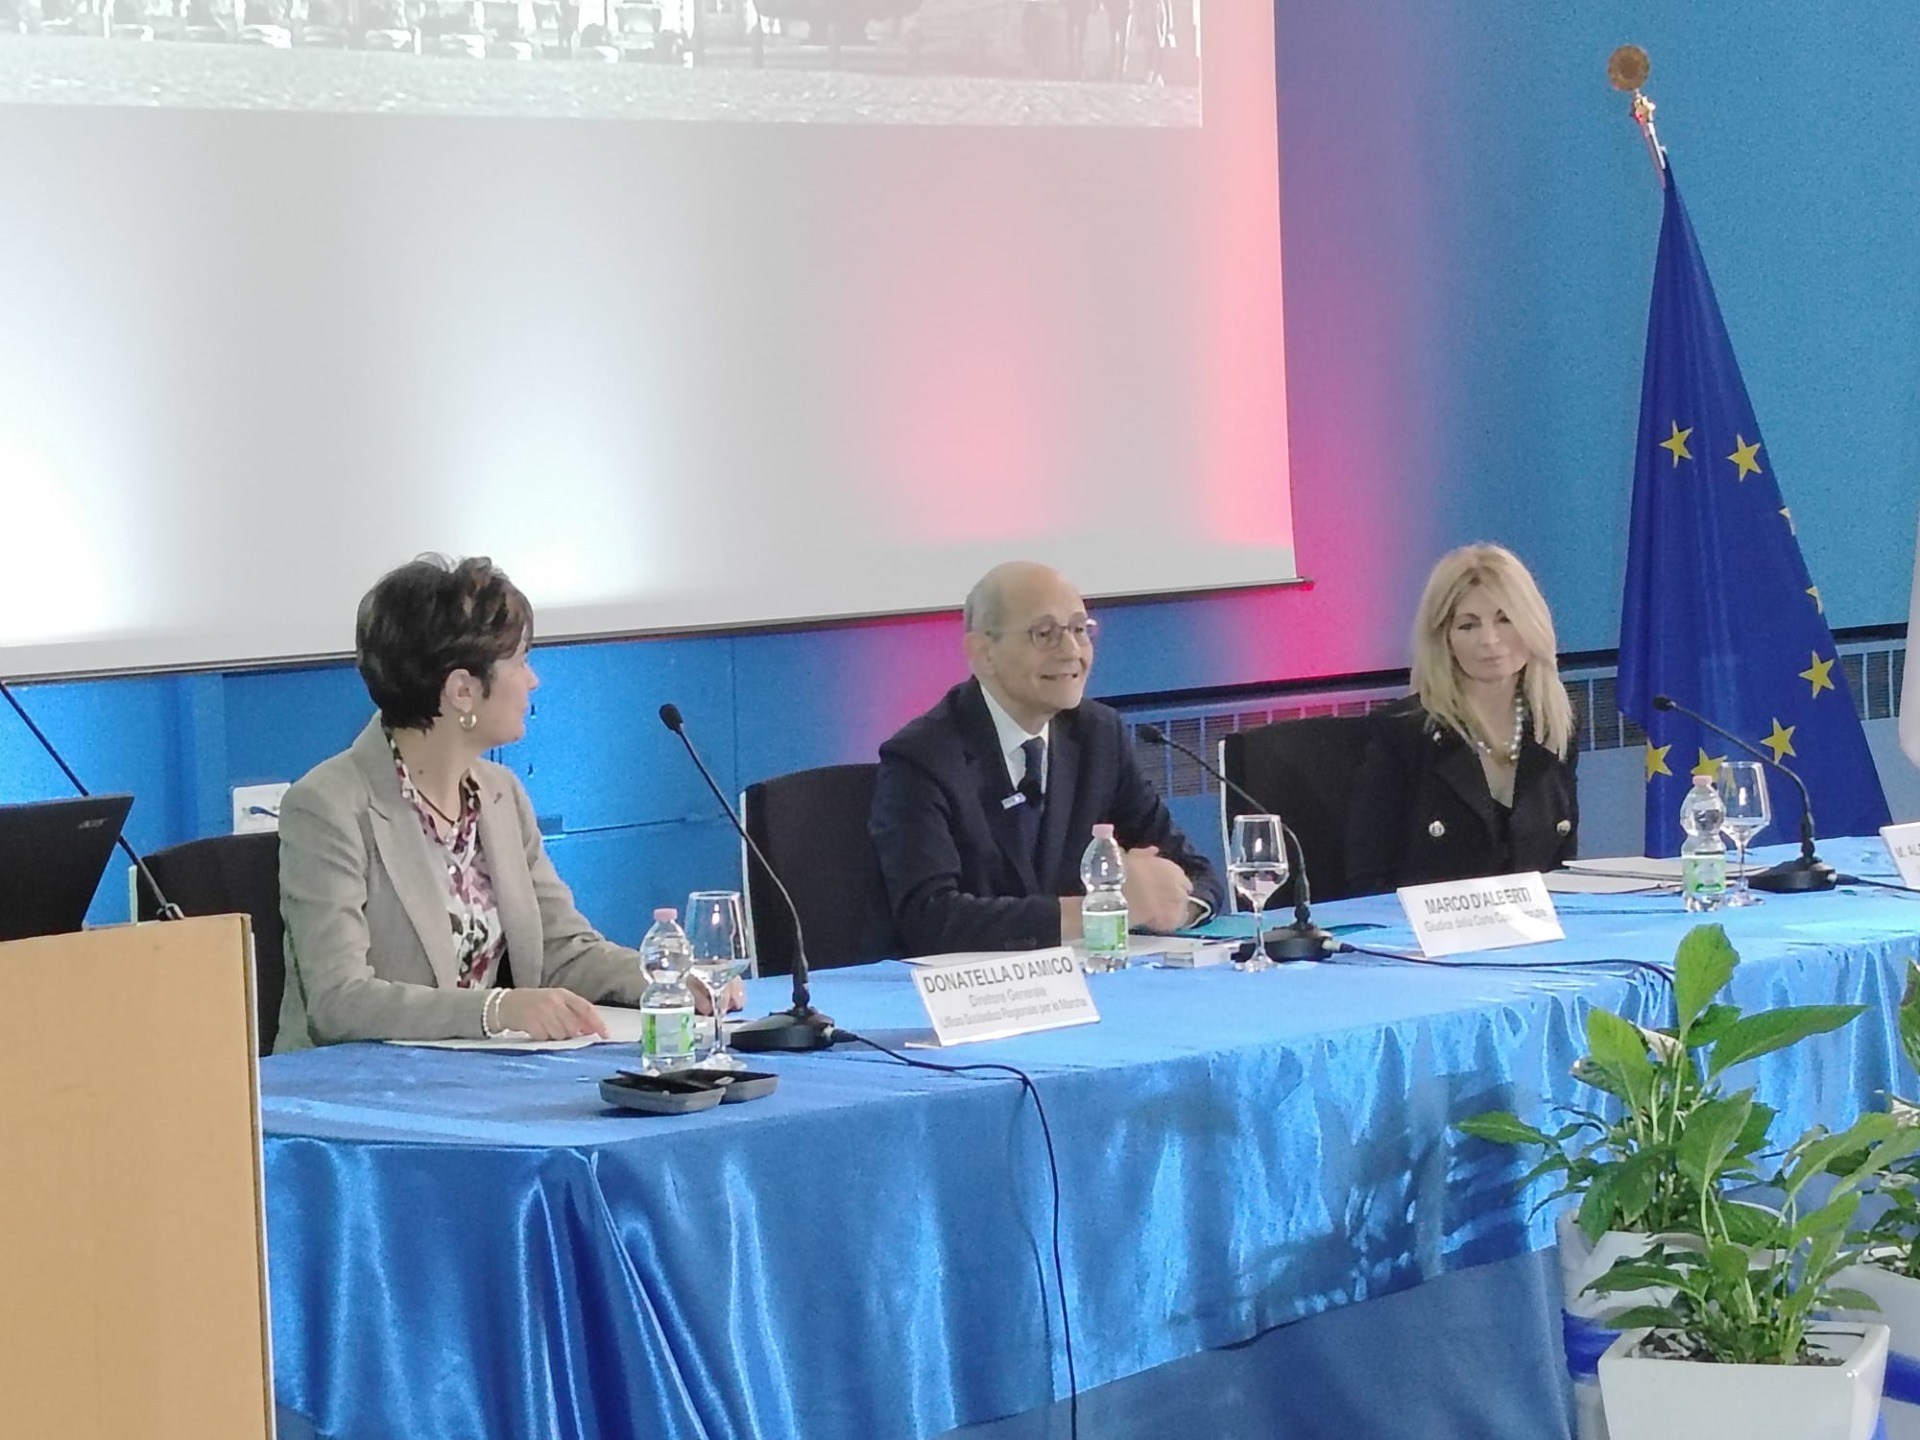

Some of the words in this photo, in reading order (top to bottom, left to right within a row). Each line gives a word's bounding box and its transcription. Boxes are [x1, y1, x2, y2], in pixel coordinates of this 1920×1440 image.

[1424, 898, 1470, 914] MARCO
[923, 965, 1013, 994] DONATELLA
[1013, 956, 1073, 981] D'AMICO
